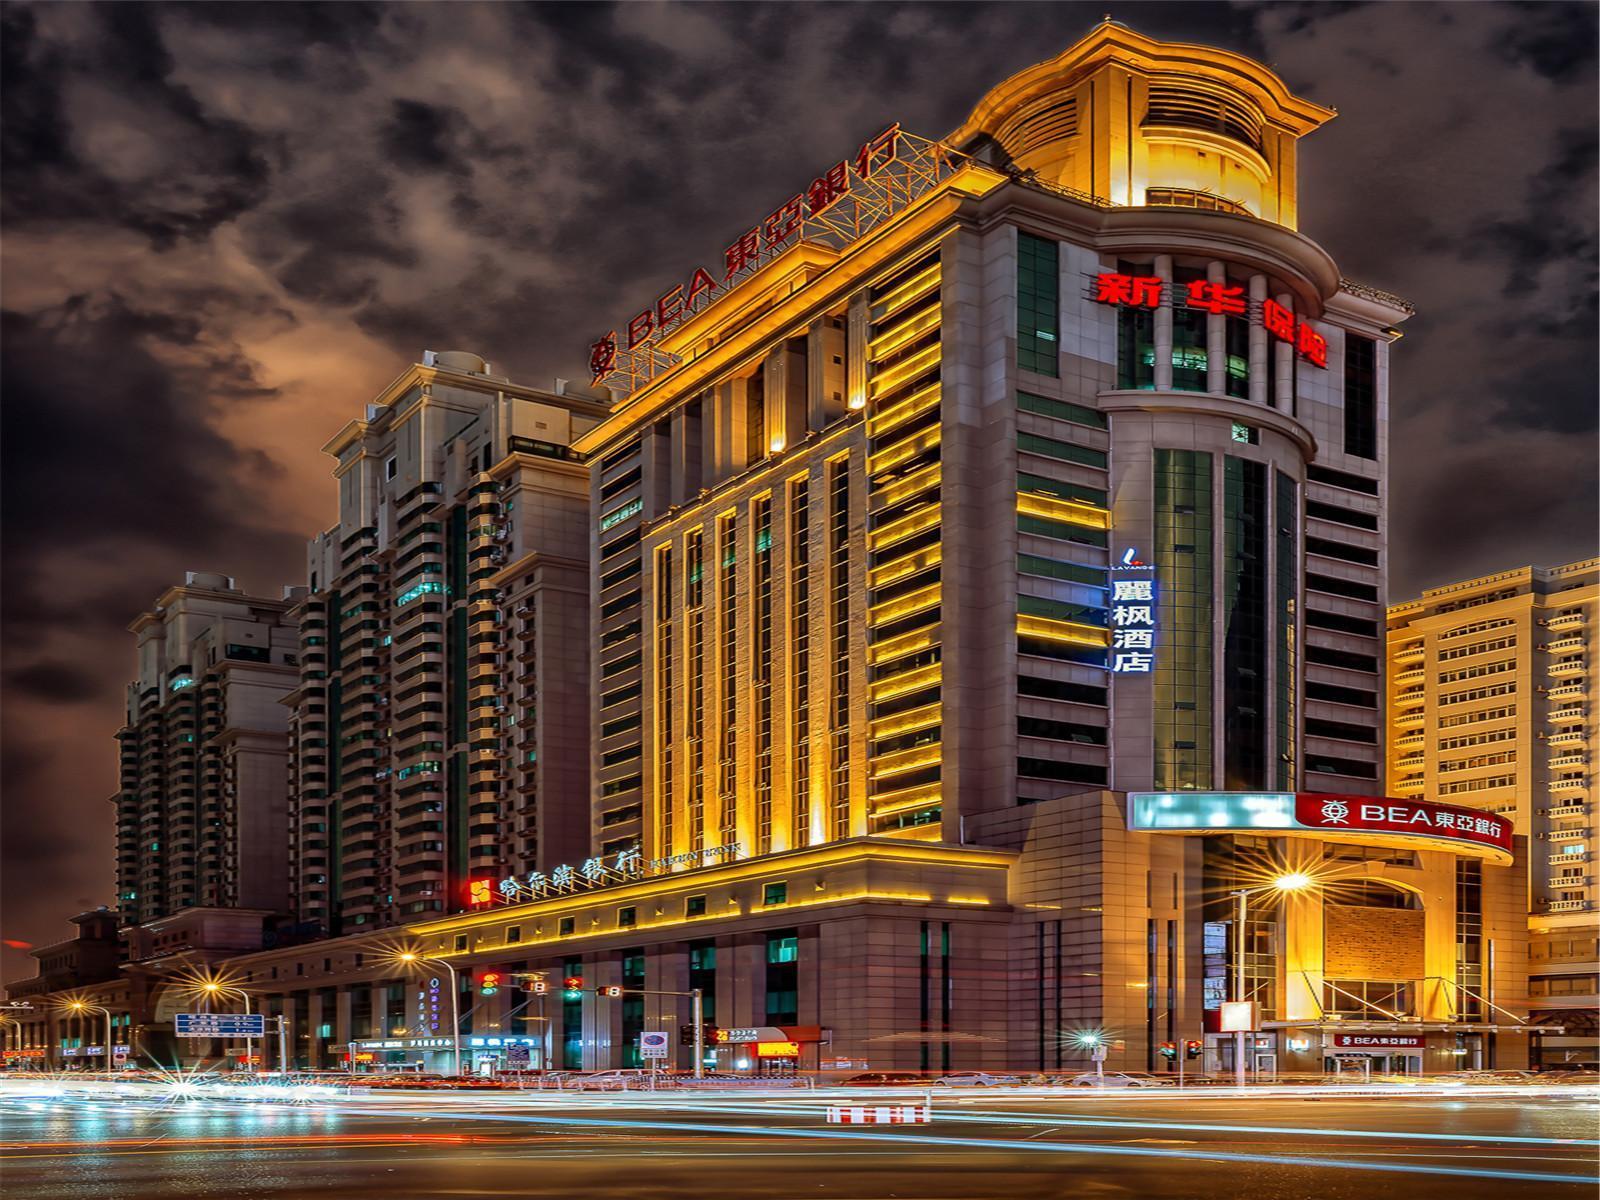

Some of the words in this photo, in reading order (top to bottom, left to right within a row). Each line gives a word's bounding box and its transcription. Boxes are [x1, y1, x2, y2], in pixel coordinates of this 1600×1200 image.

[628, 267, 717, 350] BEA
[723, 121, 900, 282] 東亞銀行
[1096, 272, 1328, 369] 新华保险
[1360, 804, 1432, 826] BEA
[1435, 811, 1502, 839] 東亞銀行
[1354, 1037, 1379, 1045] BEA
